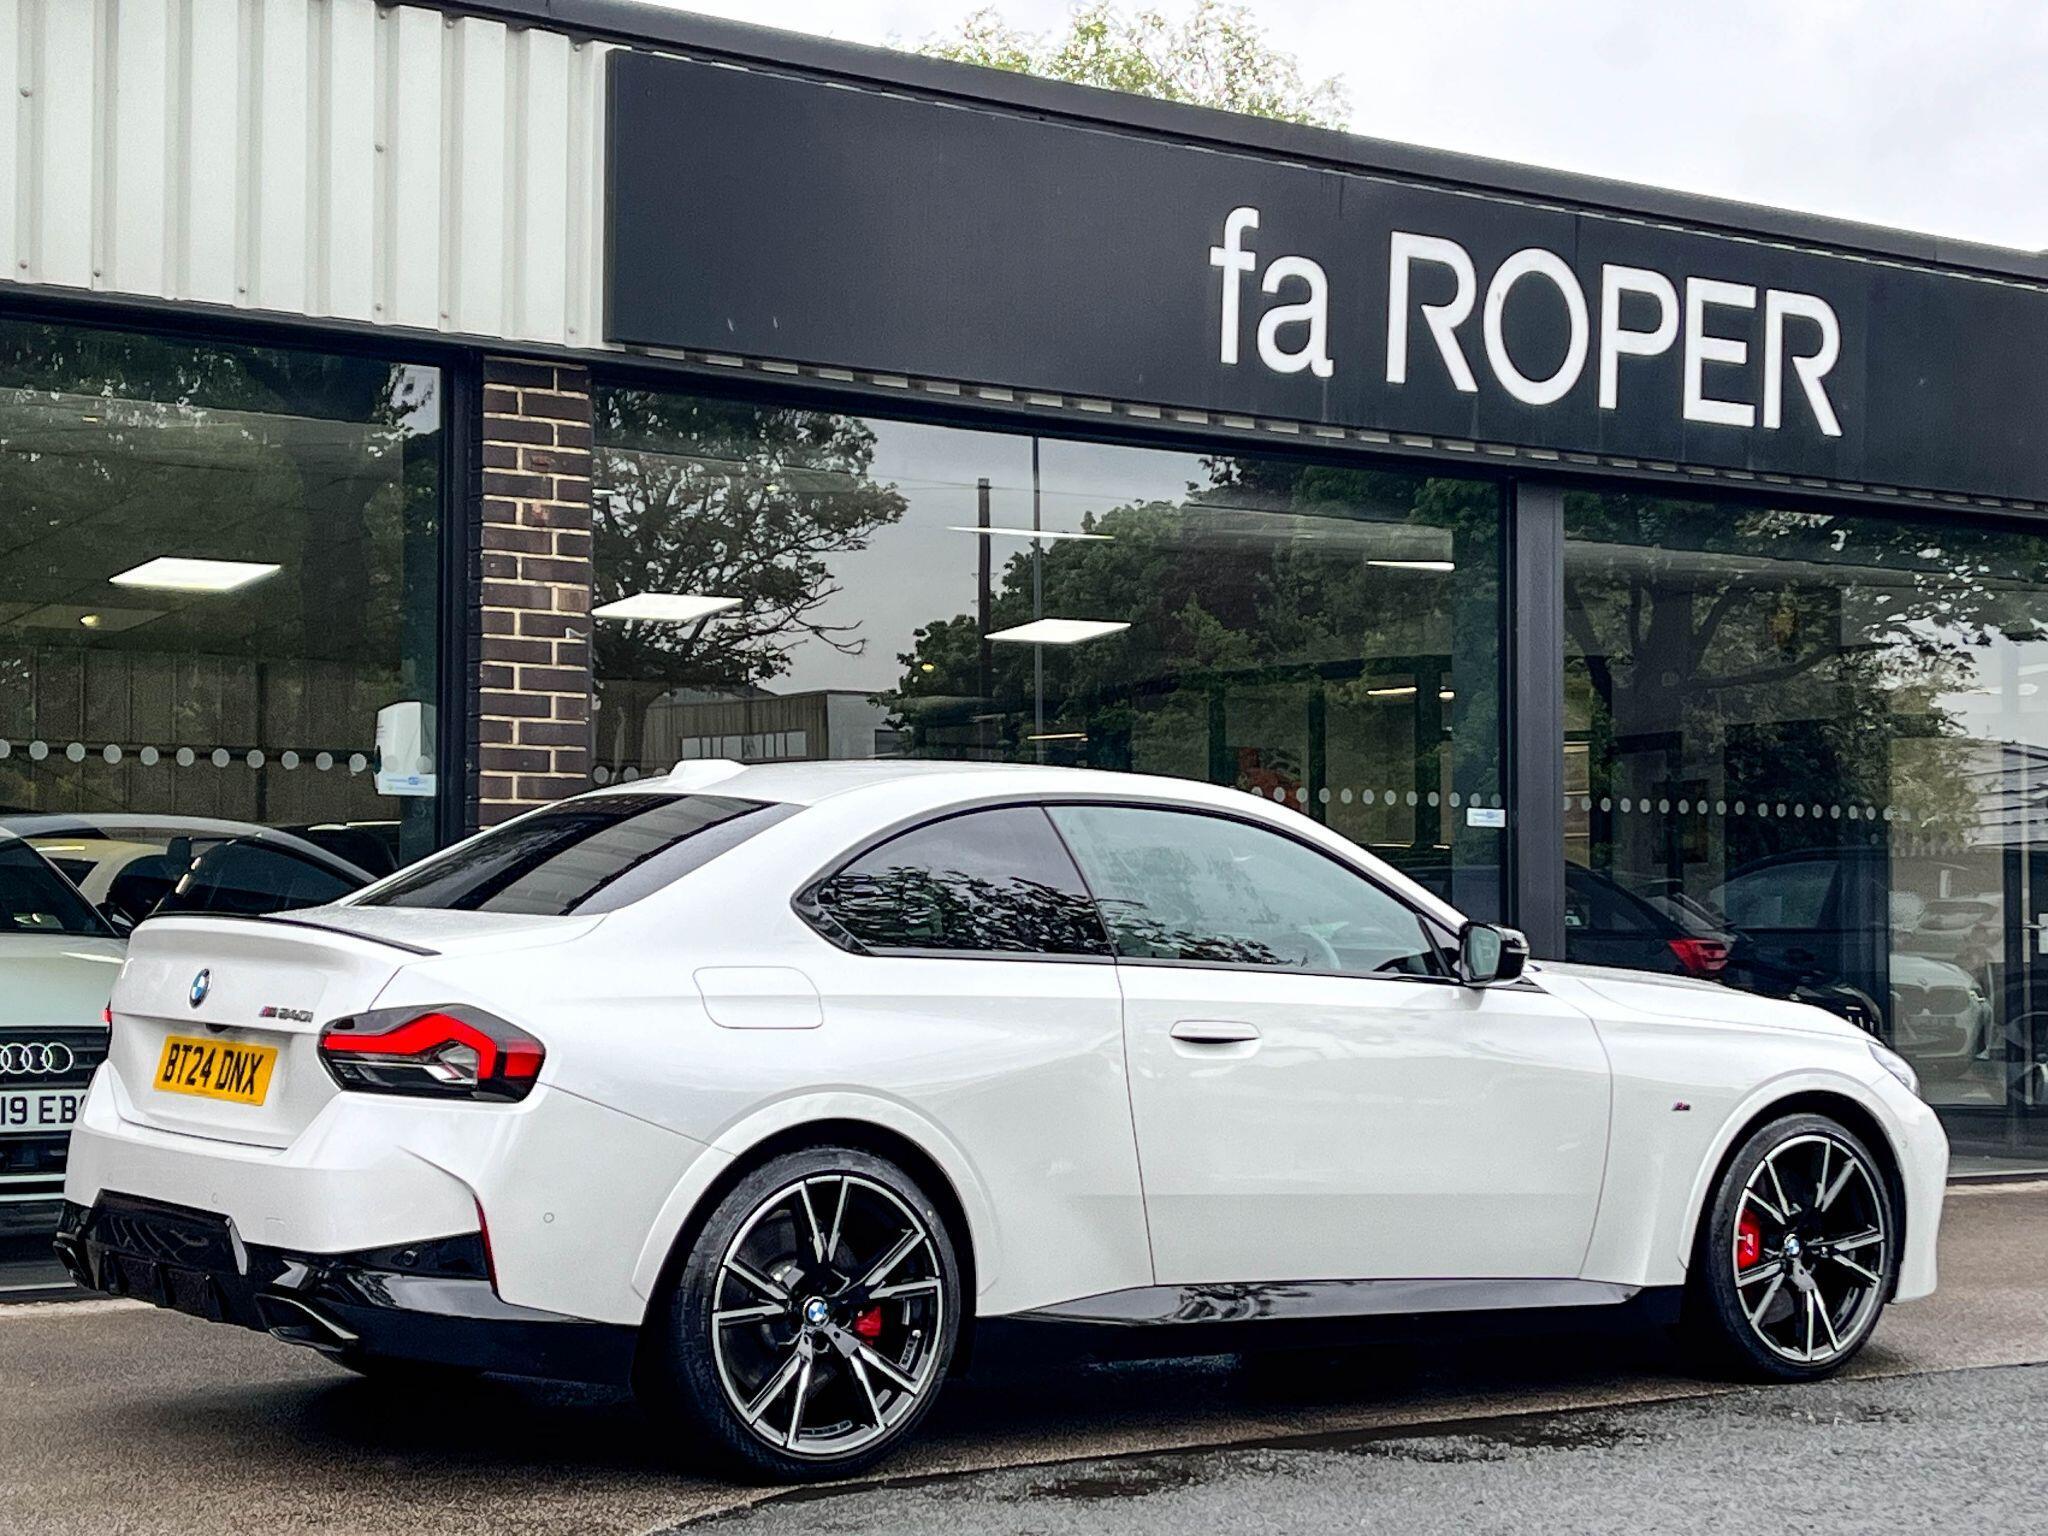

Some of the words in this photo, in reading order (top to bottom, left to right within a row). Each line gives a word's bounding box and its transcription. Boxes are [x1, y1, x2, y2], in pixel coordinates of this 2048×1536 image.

[1210, 206, 1334, 378] fa
[1386, 230, 1843, 437] ROPER
[162, 1043, 217, 1088] BT24
[214, 1049, 264, 1095] DNX
[1, 1096, 27, 1125] 19
[39, 1095, 86, 1124] EB
